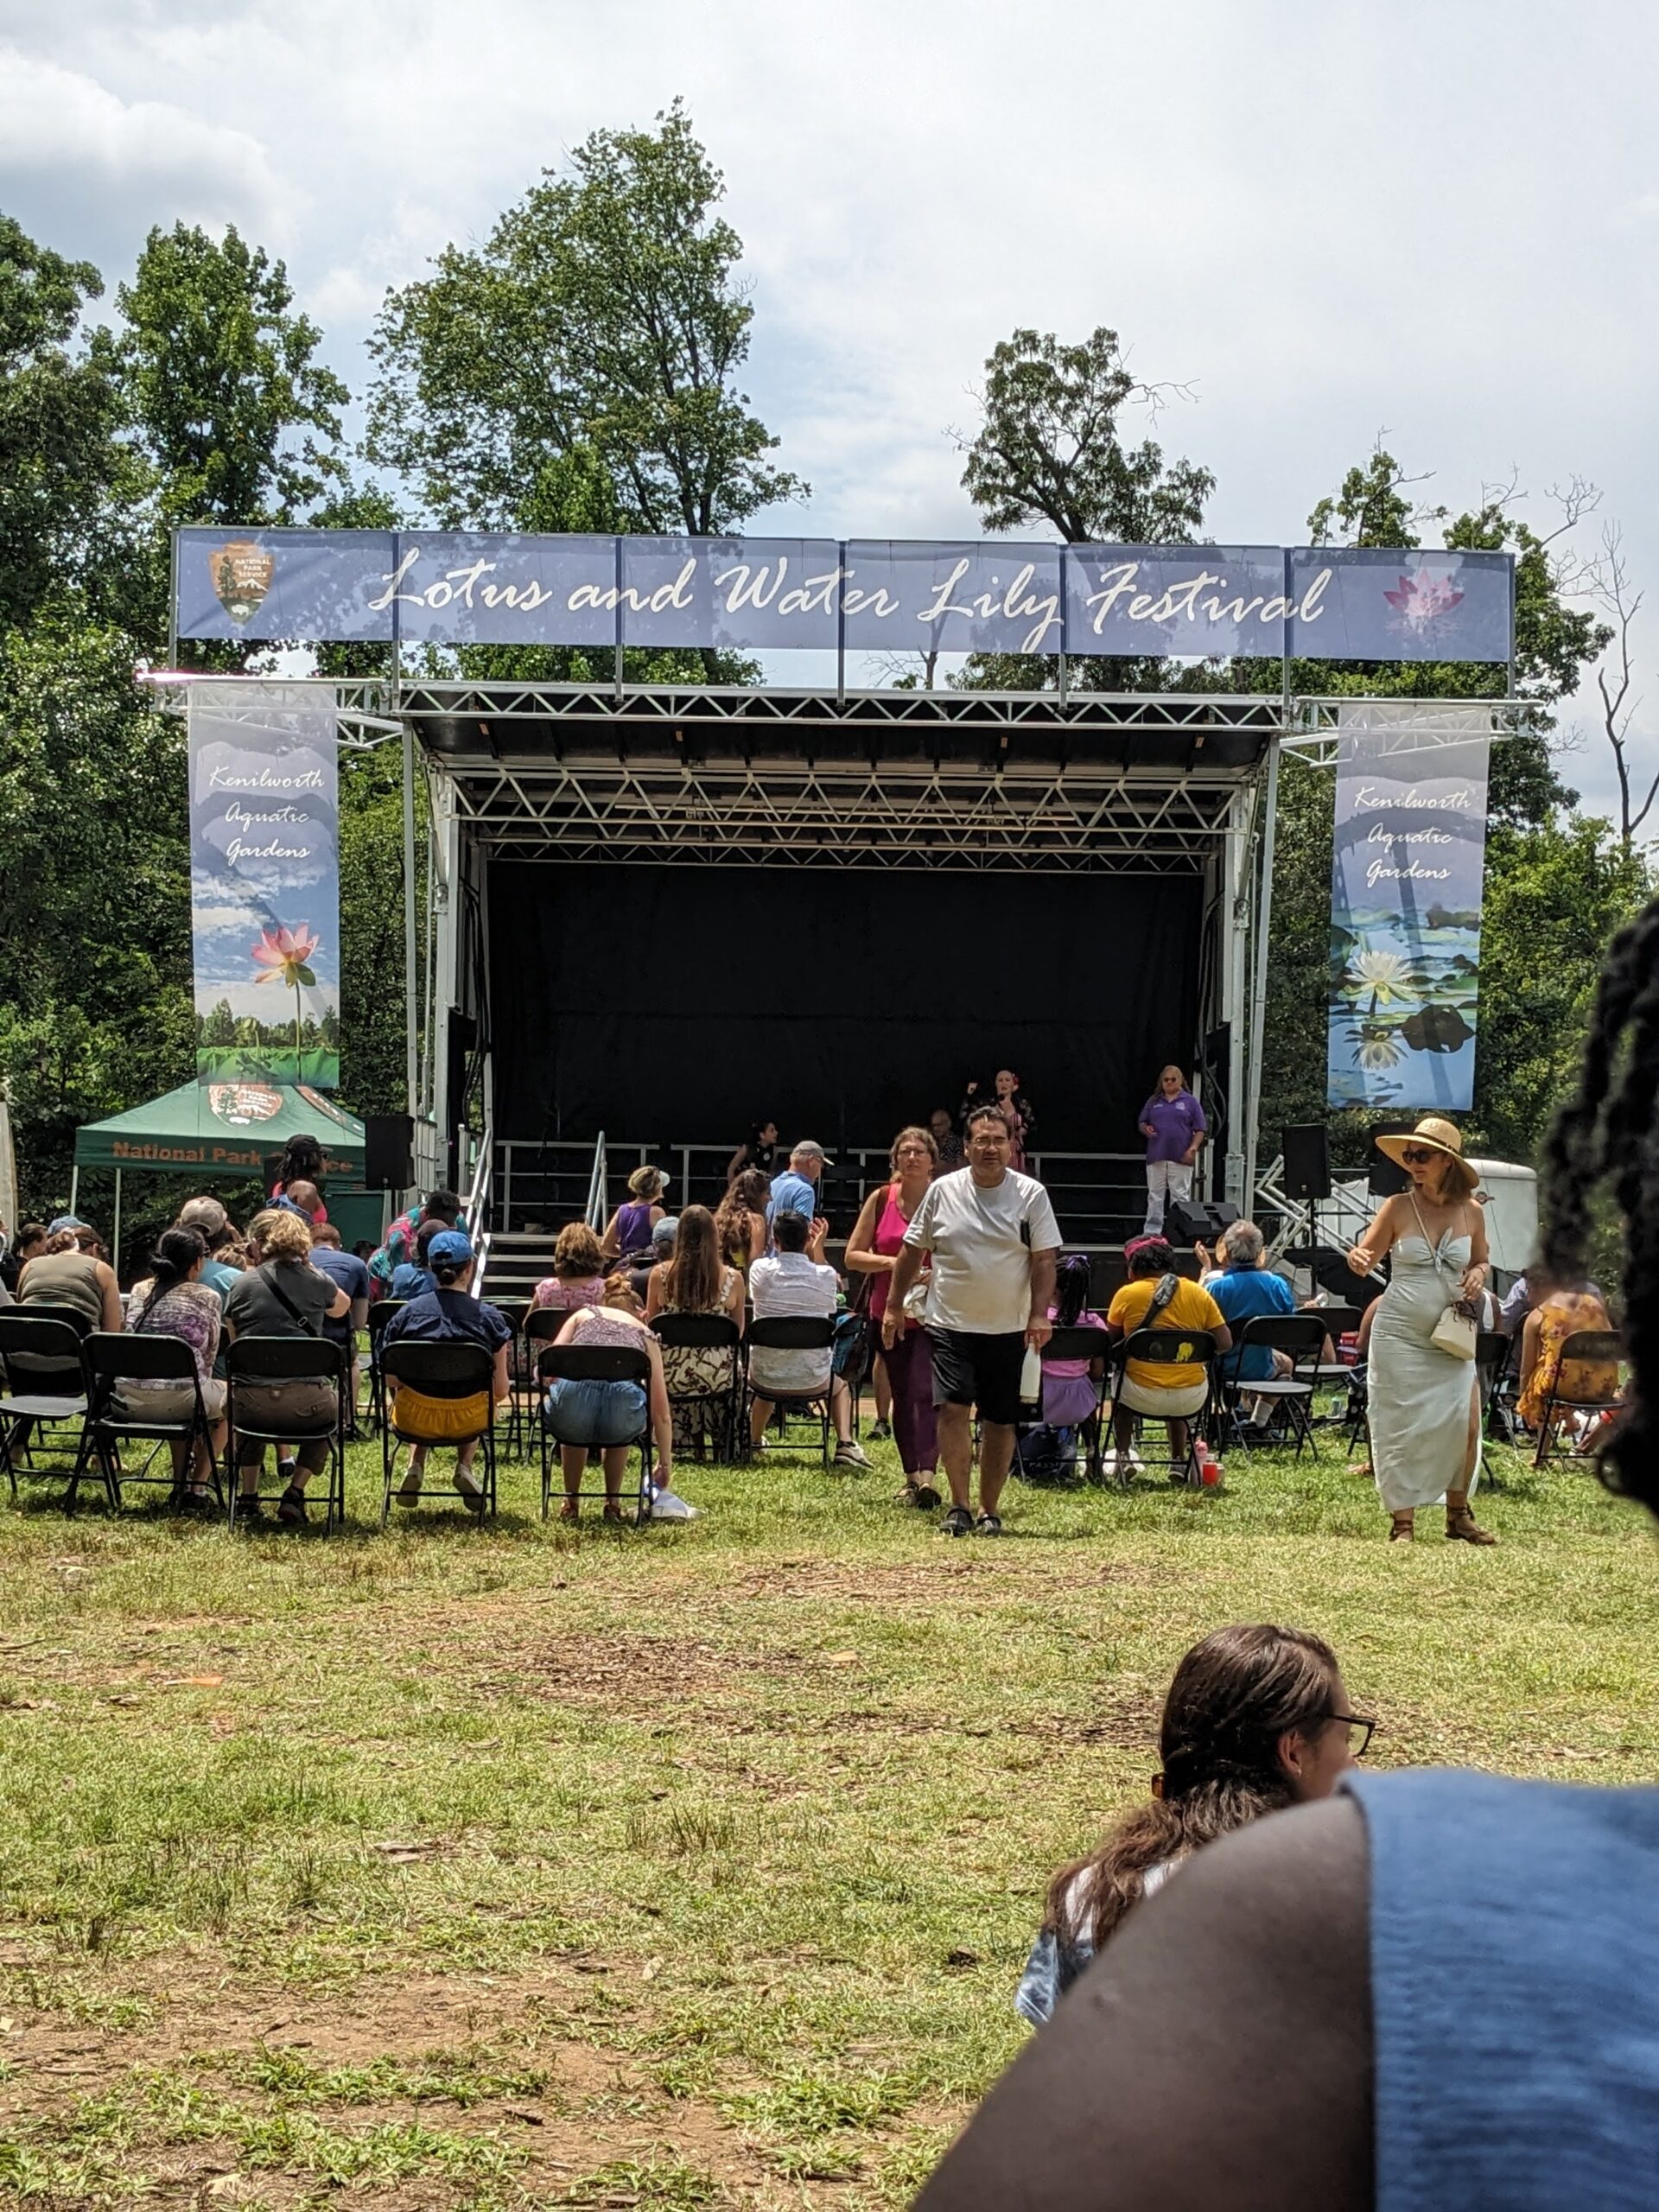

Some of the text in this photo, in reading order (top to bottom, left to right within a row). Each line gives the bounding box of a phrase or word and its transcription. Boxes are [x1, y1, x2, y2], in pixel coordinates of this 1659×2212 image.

[368, 547, 1332, 653] Lotus and Water Lily Festival
[209, 766, 325, 788] Kenilworth
[1354, 786, 1471, 809] Kenilworth
[225, 801, 309, 832] Aquatic
[226, 837, 311, 867] Gardens
[1367, 822, 1452, 854] Aquatic
[1365, 858, 1452, 888] Gardens
[112, 1141, 205, 1162] National
[213, 1147, 263, 1166] Park
